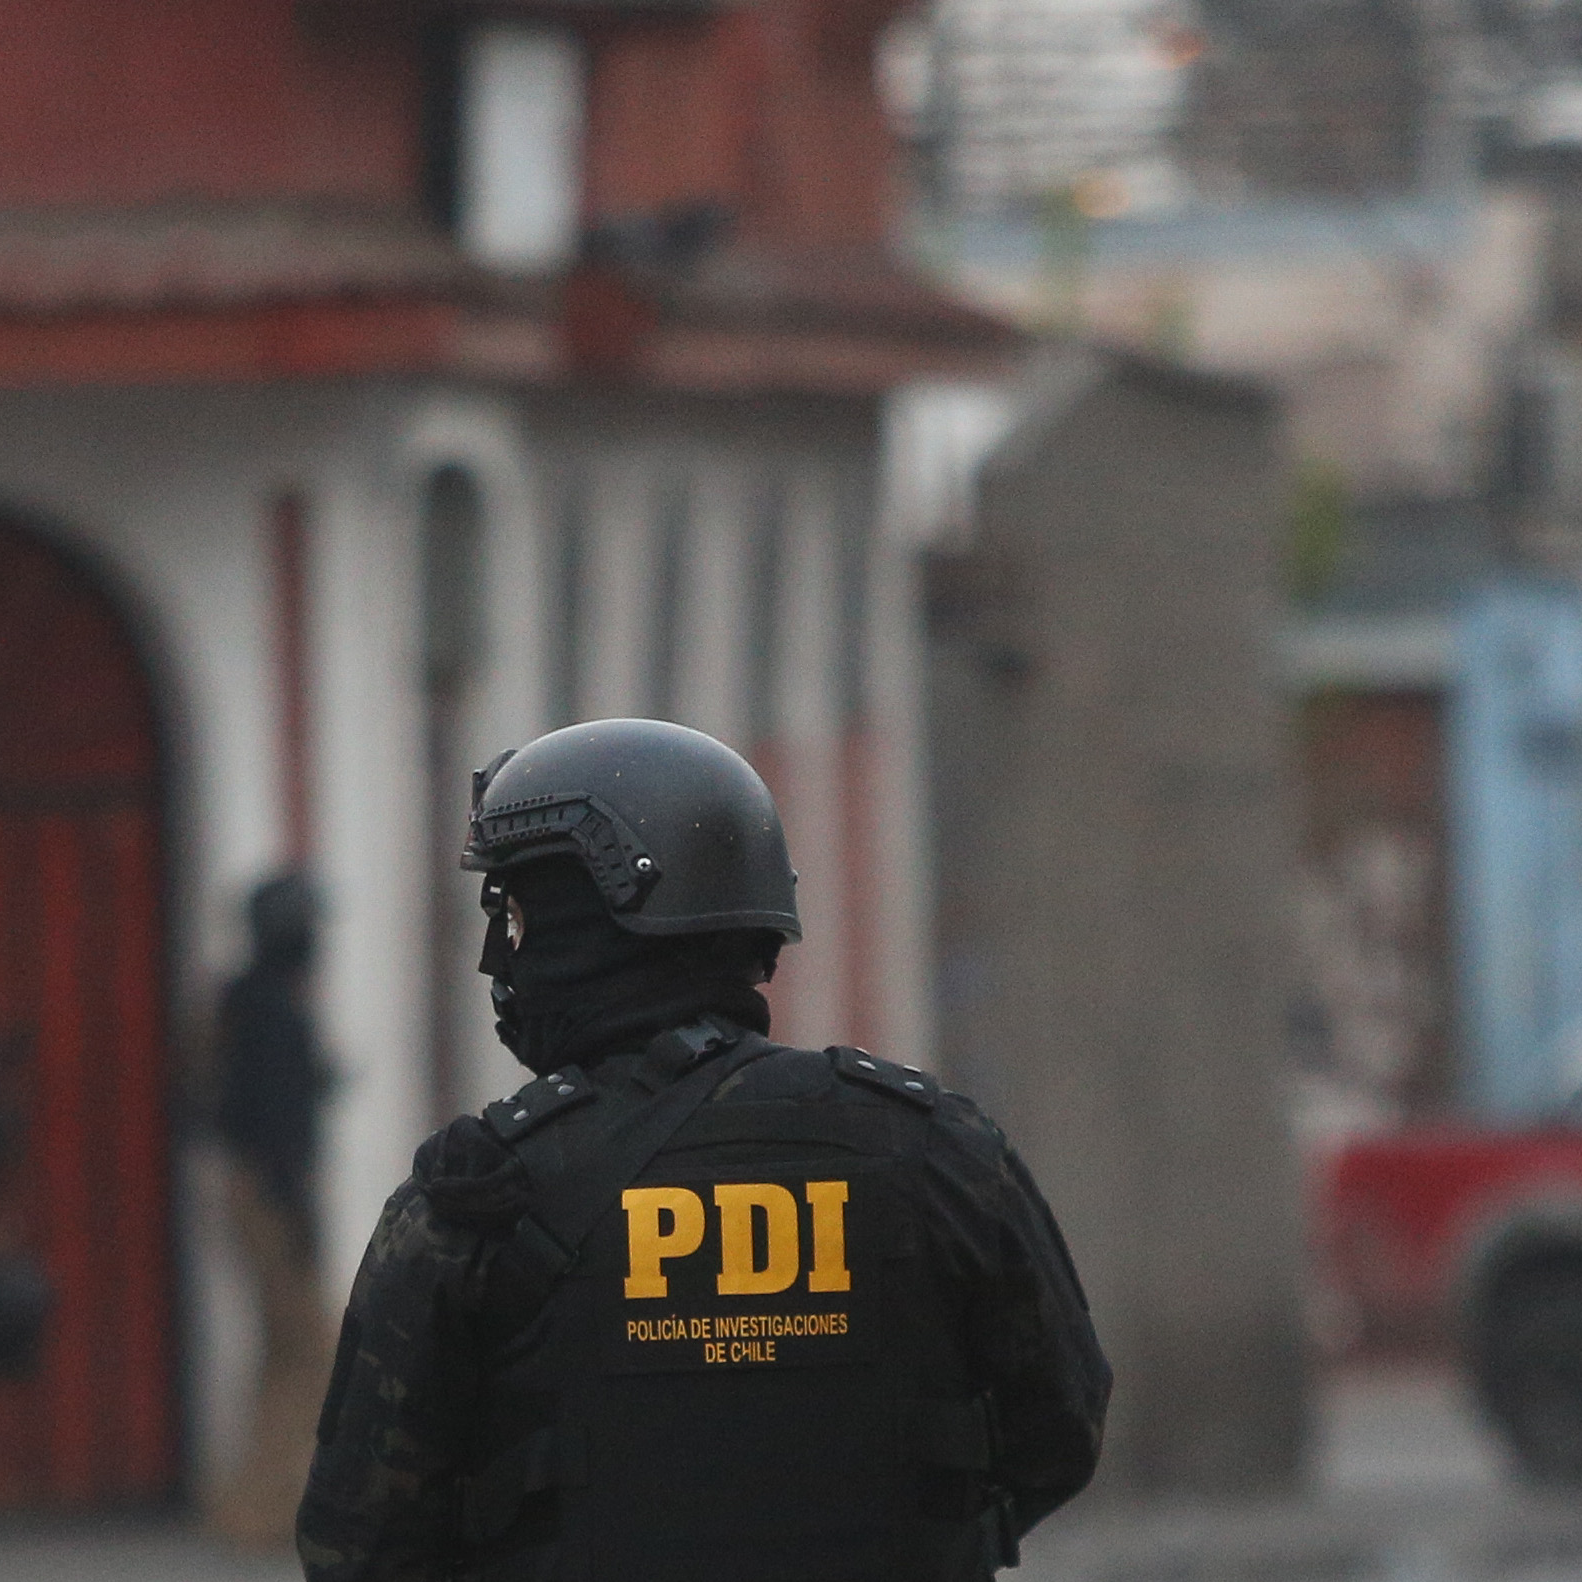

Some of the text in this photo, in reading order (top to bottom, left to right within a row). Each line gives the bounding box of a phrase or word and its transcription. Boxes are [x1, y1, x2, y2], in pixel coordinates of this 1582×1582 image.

[621, 1181, 851, 1299] PDI
[627, 1313, 848, 1341] POLICÍA DE INVESTIGACIONES
[705, 1341, 776, 1363] DE CHILE
